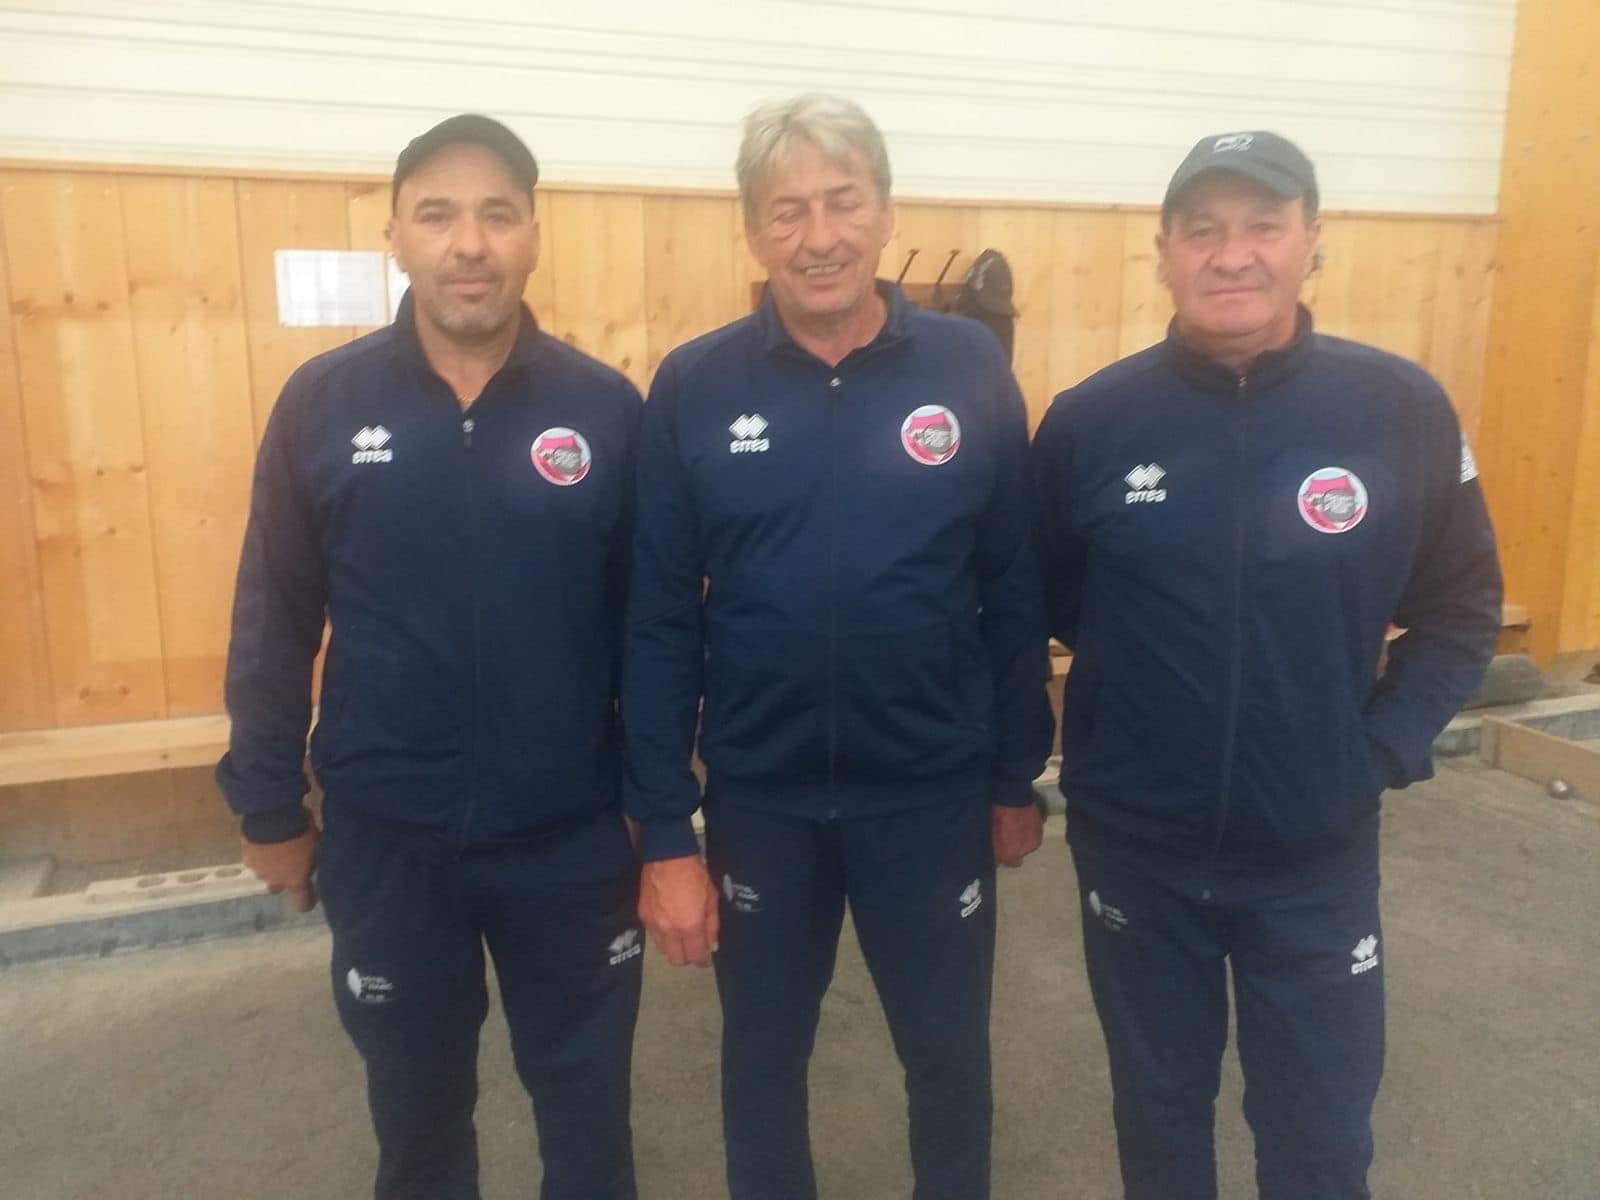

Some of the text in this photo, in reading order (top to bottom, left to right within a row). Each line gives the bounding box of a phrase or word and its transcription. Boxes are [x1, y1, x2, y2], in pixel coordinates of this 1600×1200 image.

[730, 438, 770, 454] errea
[352, 449, 392, 464] errea
[1125, 489, 1167, 504] errea
